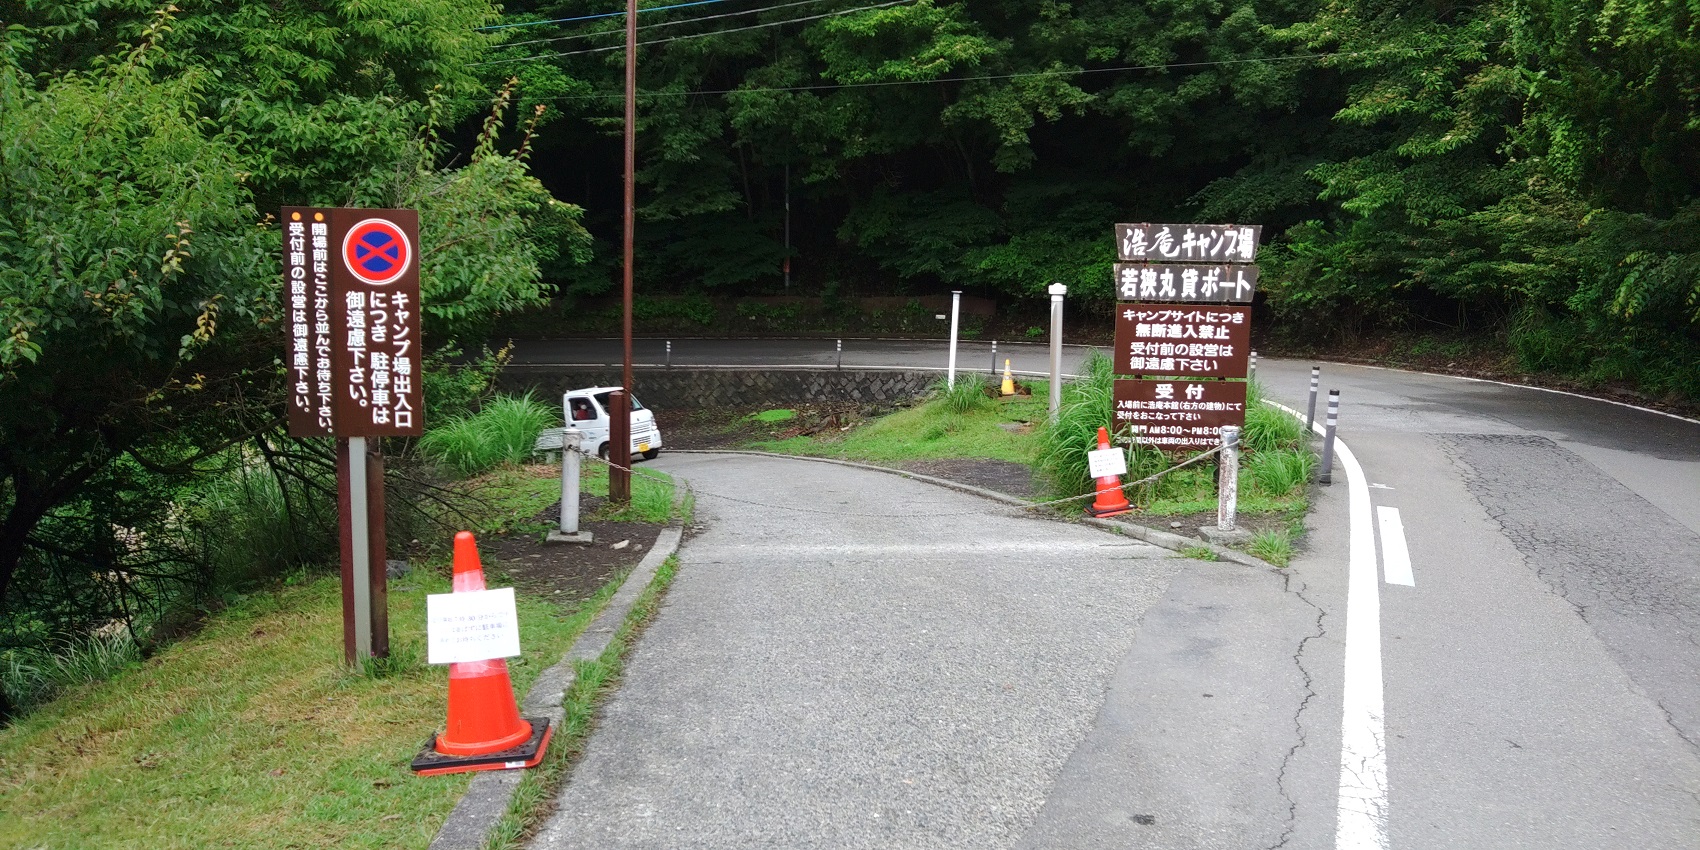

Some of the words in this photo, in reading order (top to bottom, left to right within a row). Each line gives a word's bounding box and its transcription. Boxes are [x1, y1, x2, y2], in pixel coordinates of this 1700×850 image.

[288, 222, 310, 413] 受付前の設営は御遠慮下さい。
[369, 291, 388, 342] につき
[1123, 309, 1244, 324] キャンプサイトにつき
[1135, 323, 1230, 340] 無断進入禁止
[345, 290, 368, 407] 御遠慮下さい。
[391, 291, 412, 428] キャンプ場出入口
[1129, 341, 1234, 357] 受付前の設営は
[1129, 357, 1218, 371] 御遠慮下さい
[370, 351, 390, 424] 駐停車は
[1116, 411, 1201, 421] 受付をおこなって下さい
